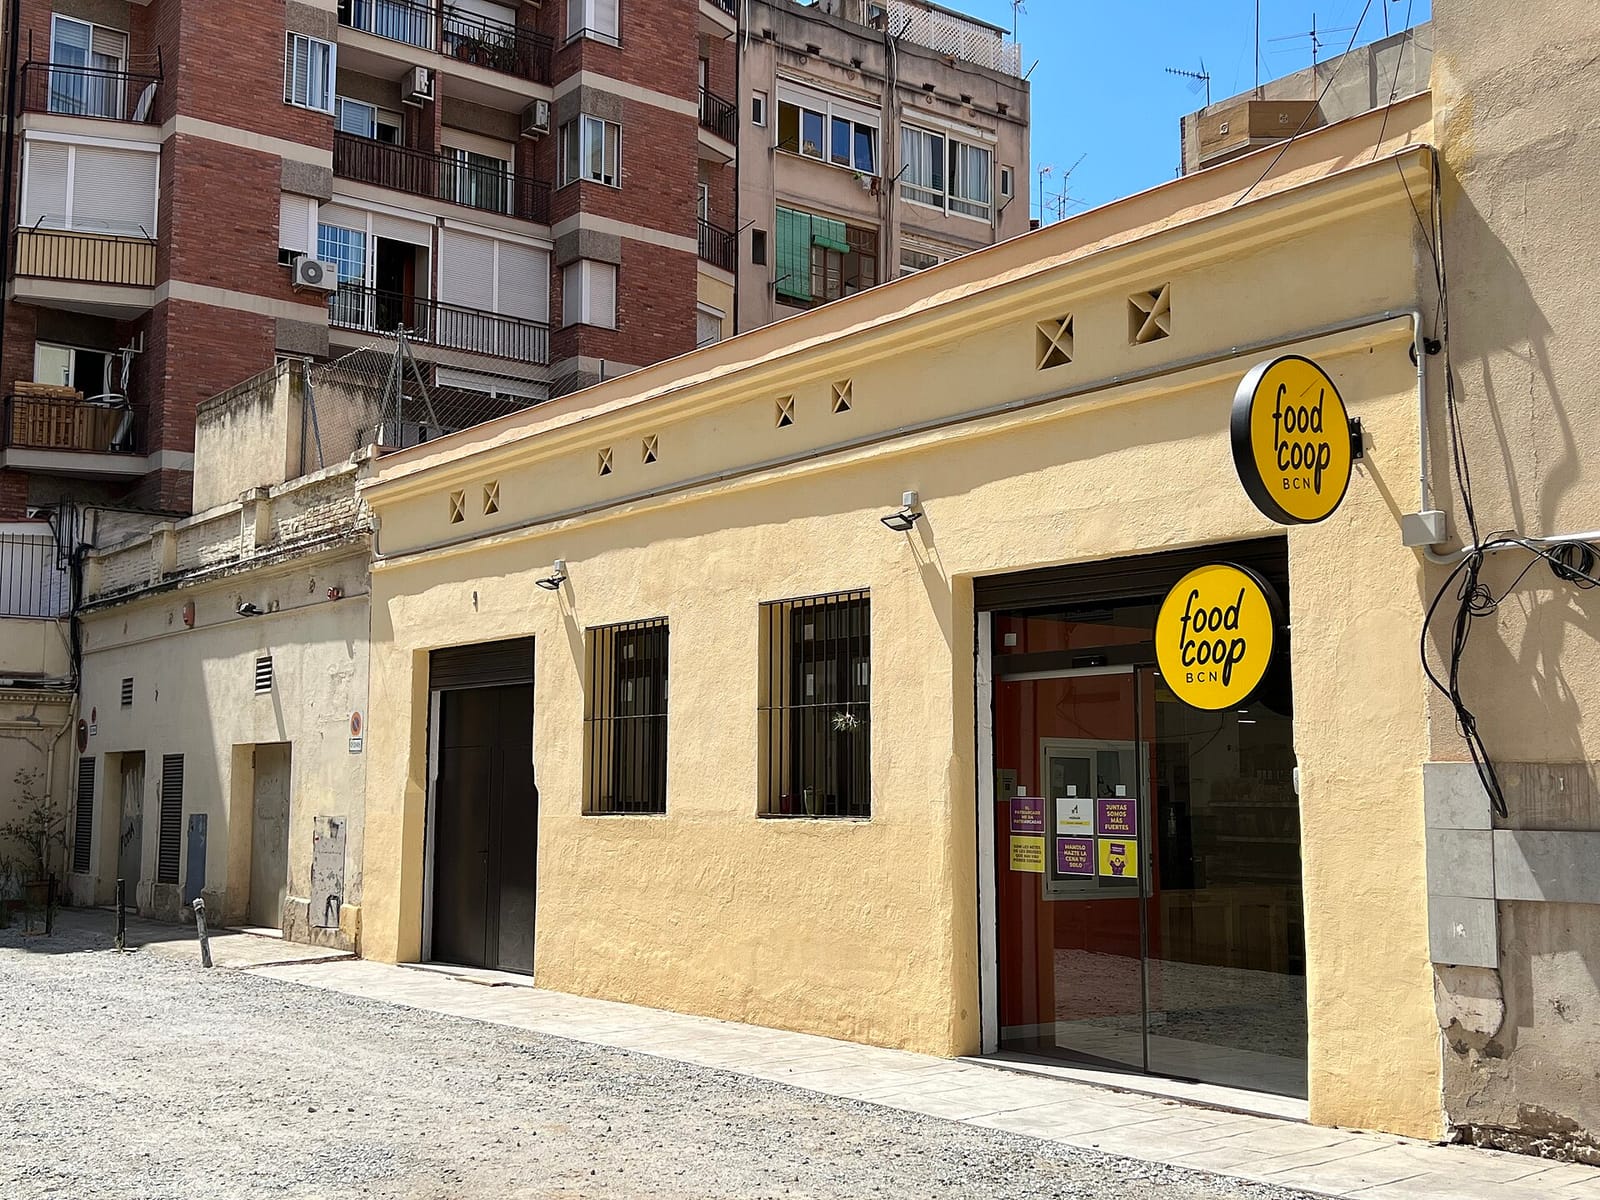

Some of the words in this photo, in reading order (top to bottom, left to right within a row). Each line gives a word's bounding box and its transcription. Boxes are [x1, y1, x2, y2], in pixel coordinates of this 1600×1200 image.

[1272, 383, 1324, 451] food
[1277, 440, 1331, 495] coop
[1282, 477, 1311, 490] BCN
[1180, 587, 1246, 650] food
[1181, 638, 1247, 687] coop
[1185, 671, 1218, 683] BCN
[1104, 823, 1129, 831] FUERTES
